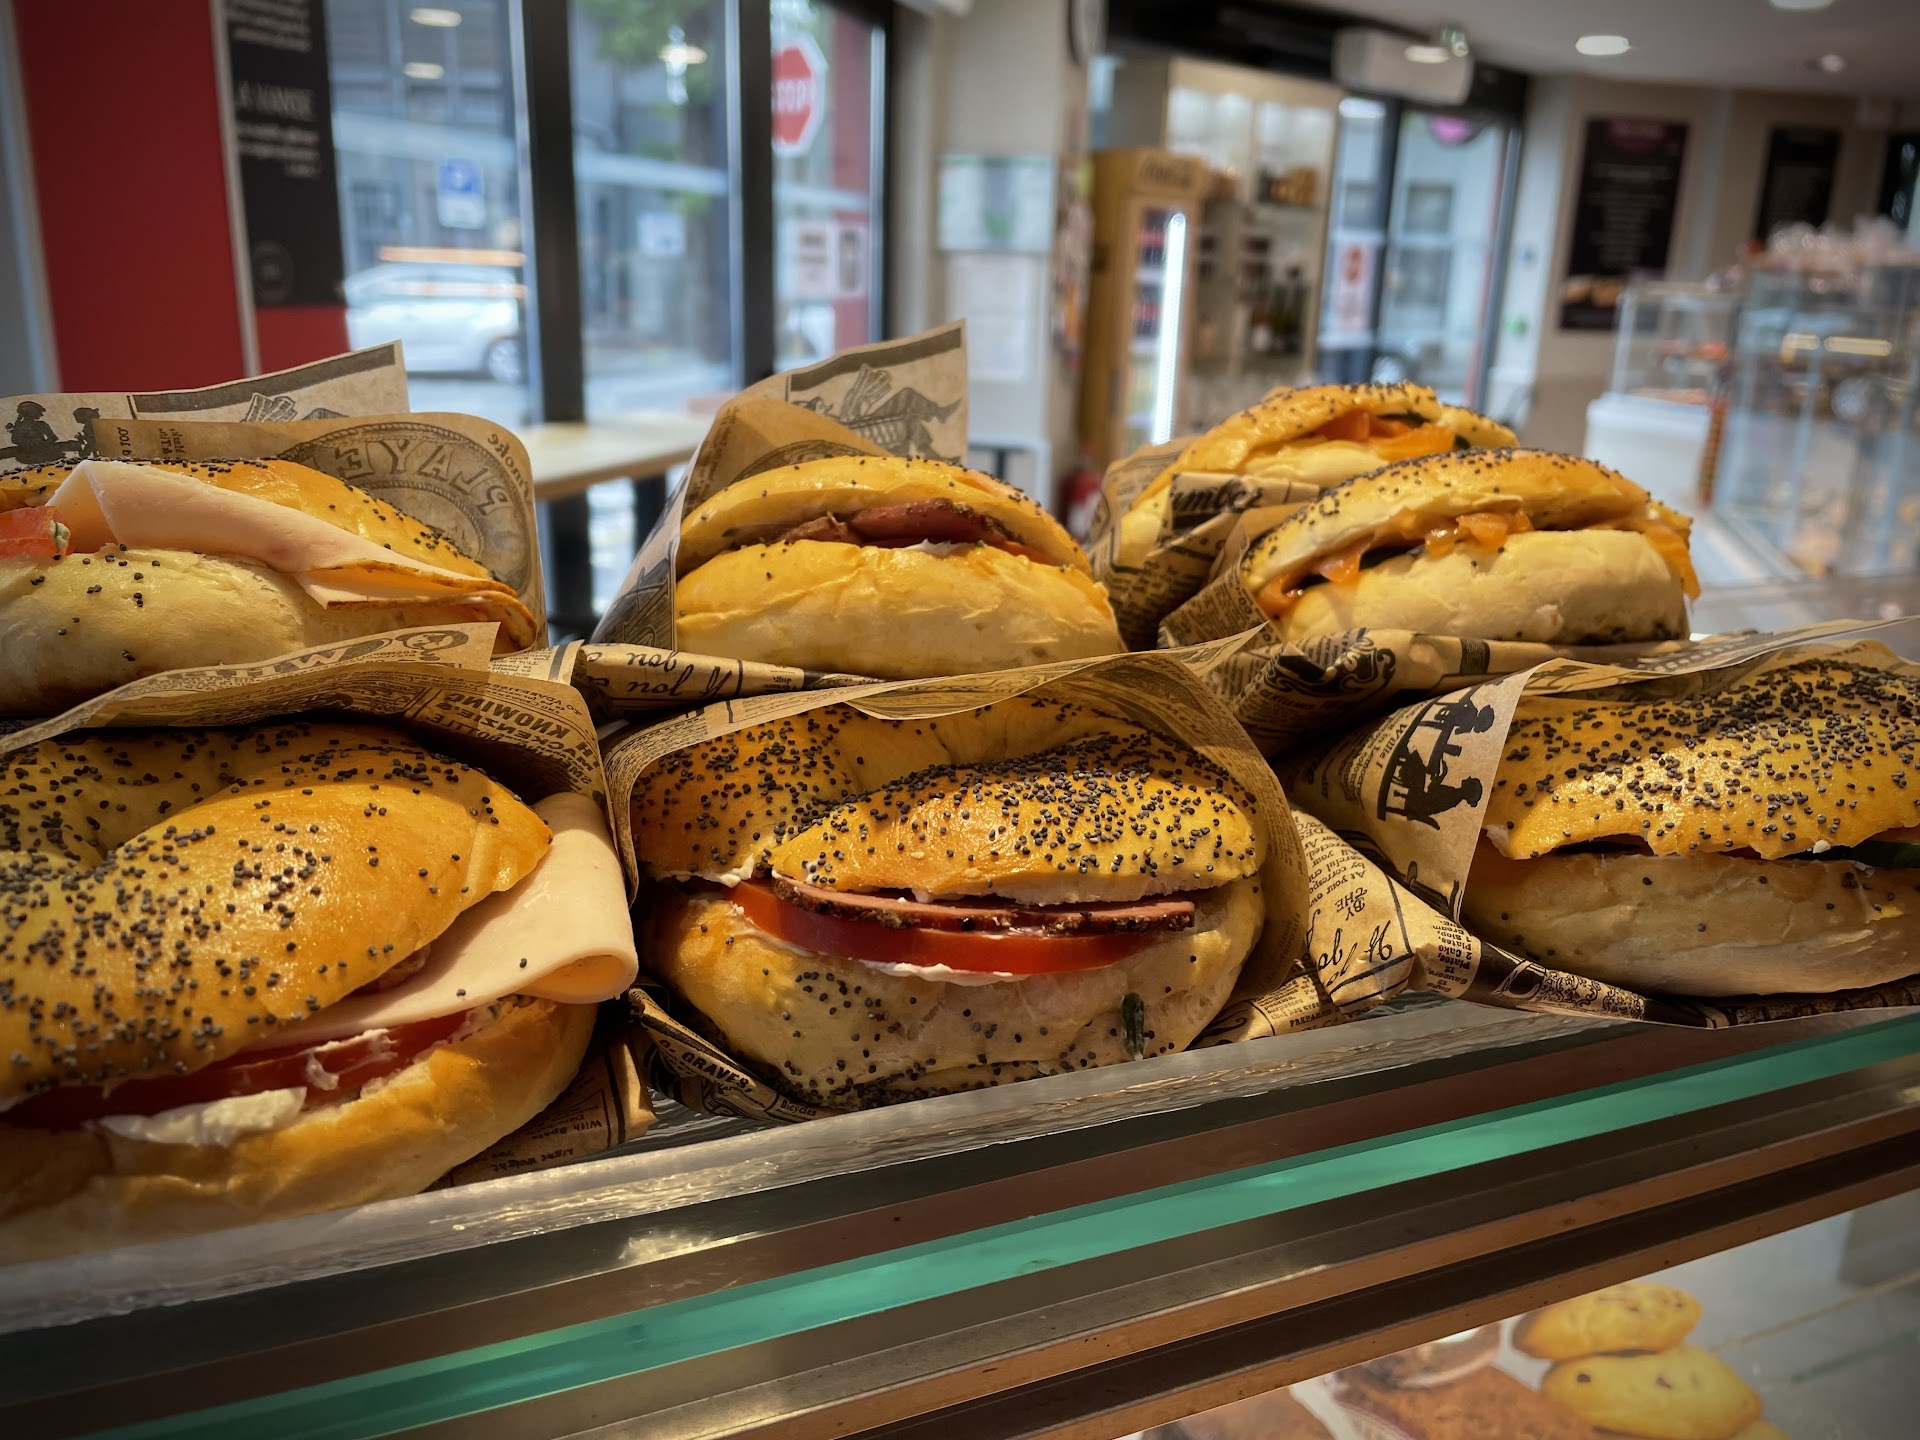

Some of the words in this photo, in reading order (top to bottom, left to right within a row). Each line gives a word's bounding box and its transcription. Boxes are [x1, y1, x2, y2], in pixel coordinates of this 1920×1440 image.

[1327, 876, 1348, 894] your
[1336, 889, 1368, 912] THE
[1346, 897, 1366, 921] BY
[1437, 944, 1462, 958] Cake
[1465, 951, 1473, 960] 2
[1443, 965, 1455, 974] 12
[685, 1053, 749, 1094] GRAVES,
[779, 1098, 818, 1118] Bicycles
